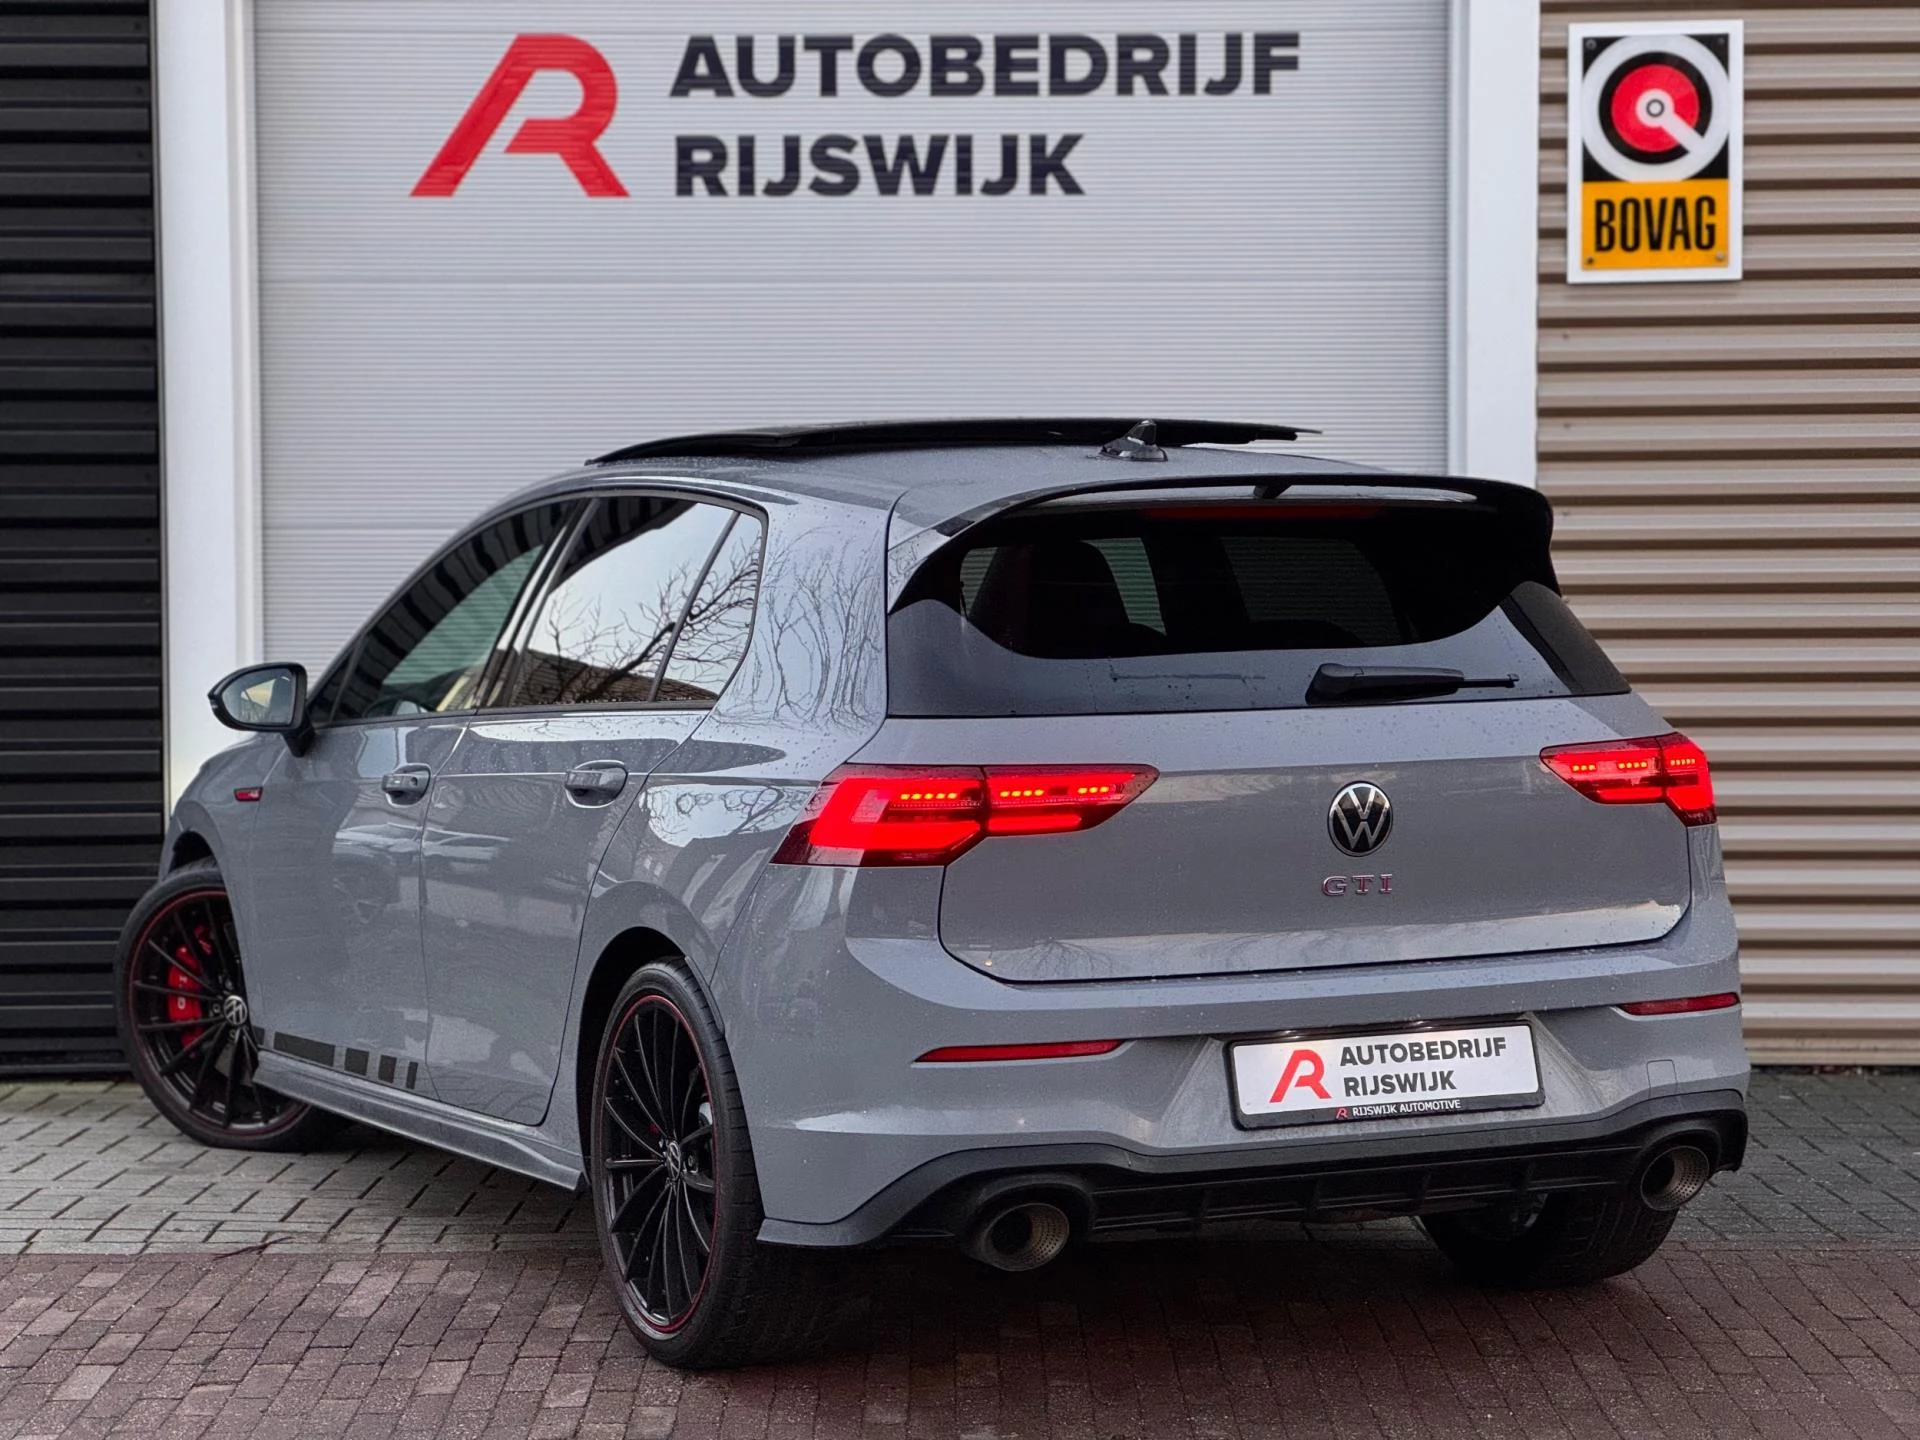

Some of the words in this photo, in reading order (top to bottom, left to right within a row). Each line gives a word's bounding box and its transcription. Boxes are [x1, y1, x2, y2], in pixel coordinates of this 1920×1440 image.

[669, 31, 1301, 98] AUTOBEDRIJF
[674, 133, 1086, 197] RIJSWIJK
[1594, 196, 1717, 254] BOVAG
[1322, 873, 1393, 896] GTI
[1339, 1037, 1507, 1067] AUTOBEDRIJF
[1343, 1070, 1457, 1097] RIJSWIJK
[1352, 1104, 1398, 1117] RIJSWIJK
[1399, 1099, 1462, 1114] AUTOMOTIVE
